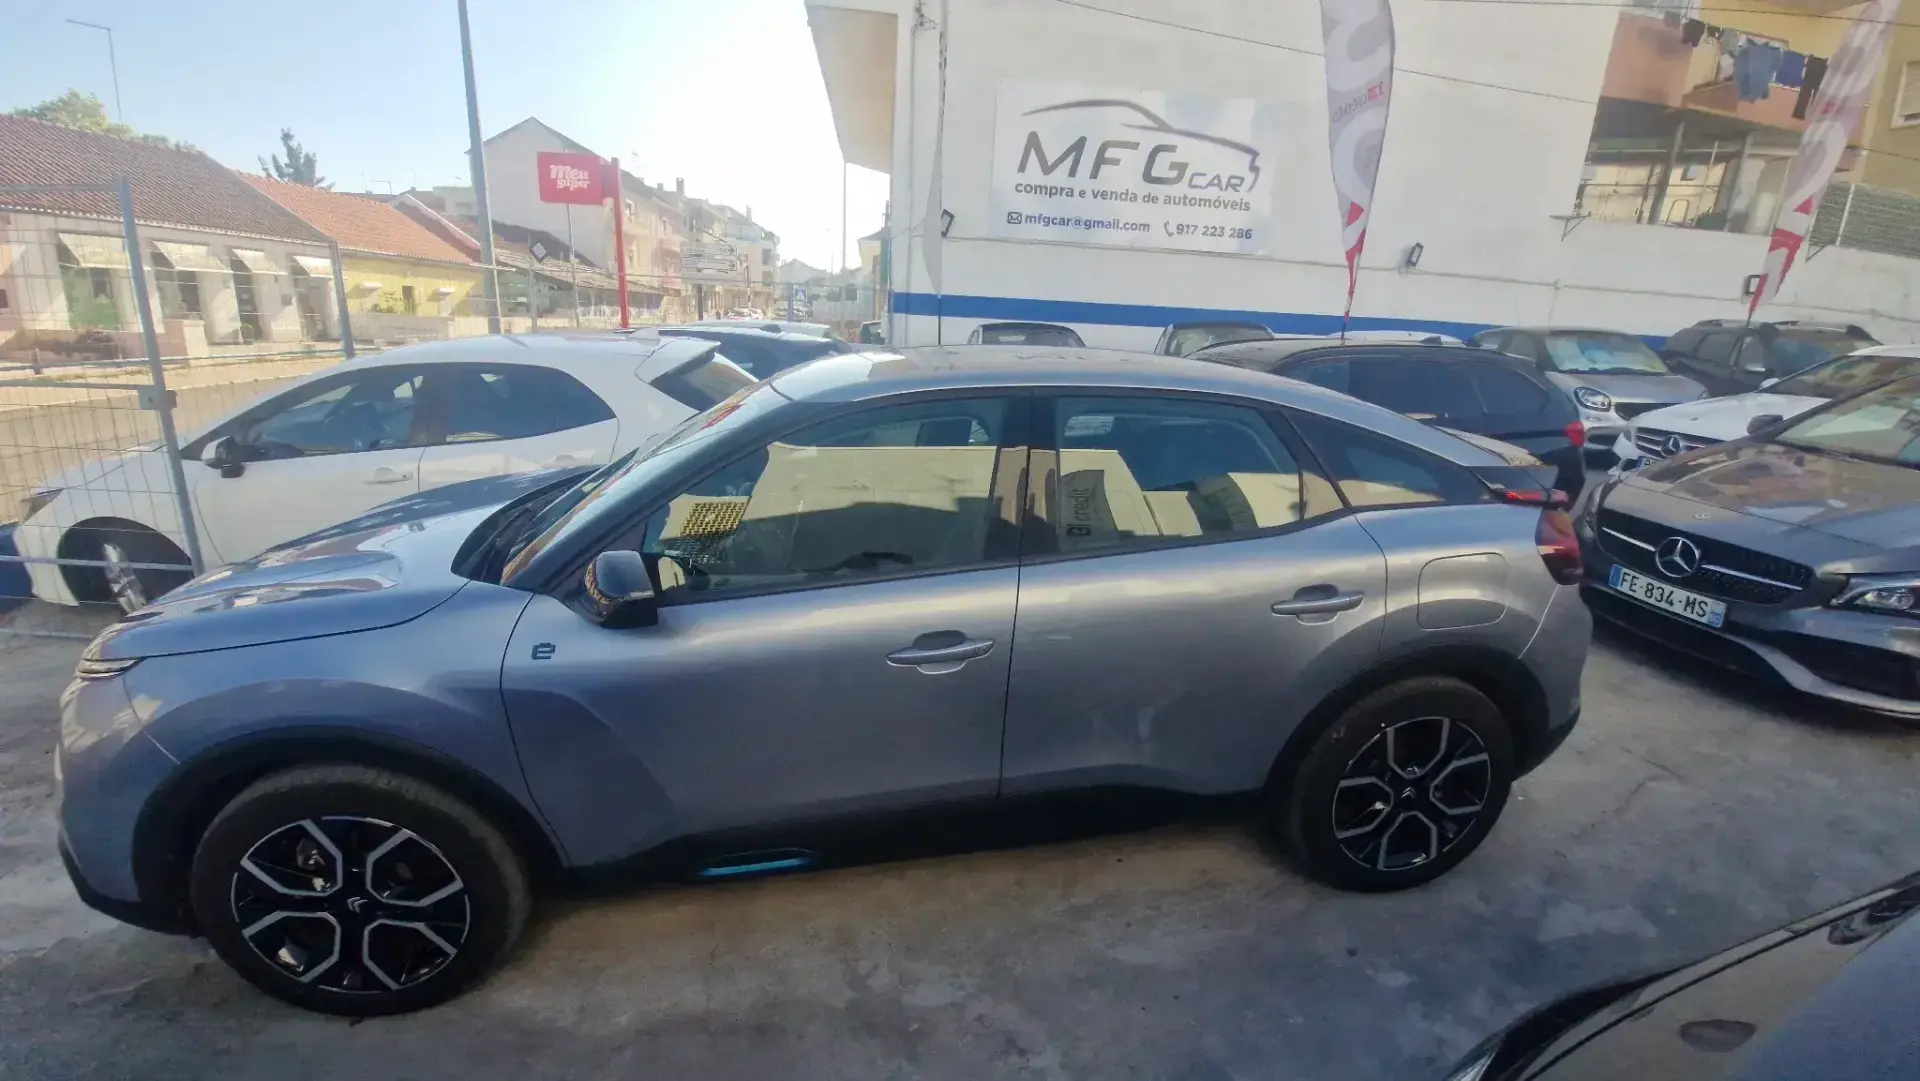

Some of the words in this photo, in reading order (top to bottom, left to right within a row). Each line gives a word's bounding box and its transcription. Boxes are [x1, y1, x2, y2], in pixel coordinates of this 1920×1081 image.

[1017, 131, 1189, 185] MFG
[1188, 172, 1245, 192] CAR
[557, 179, 590, 191] super
[1014, 181, 1074, 199] compra
[1078, 188, 1087, 199] e
[1091, 186, 1138, 203] venda
[1142, 192, 1159, 205] de
[1163, 193, 1251, 212] automóveis
[1024, 212, 1150, 233] mfgcar@gmail.com
[1175, 223, 1197, 236] 917
[1201, 224, 1225, 238] 223
[1229, 226, 1253, 240] 286
[1620, 572, 1709, 618] FE-834-MS
